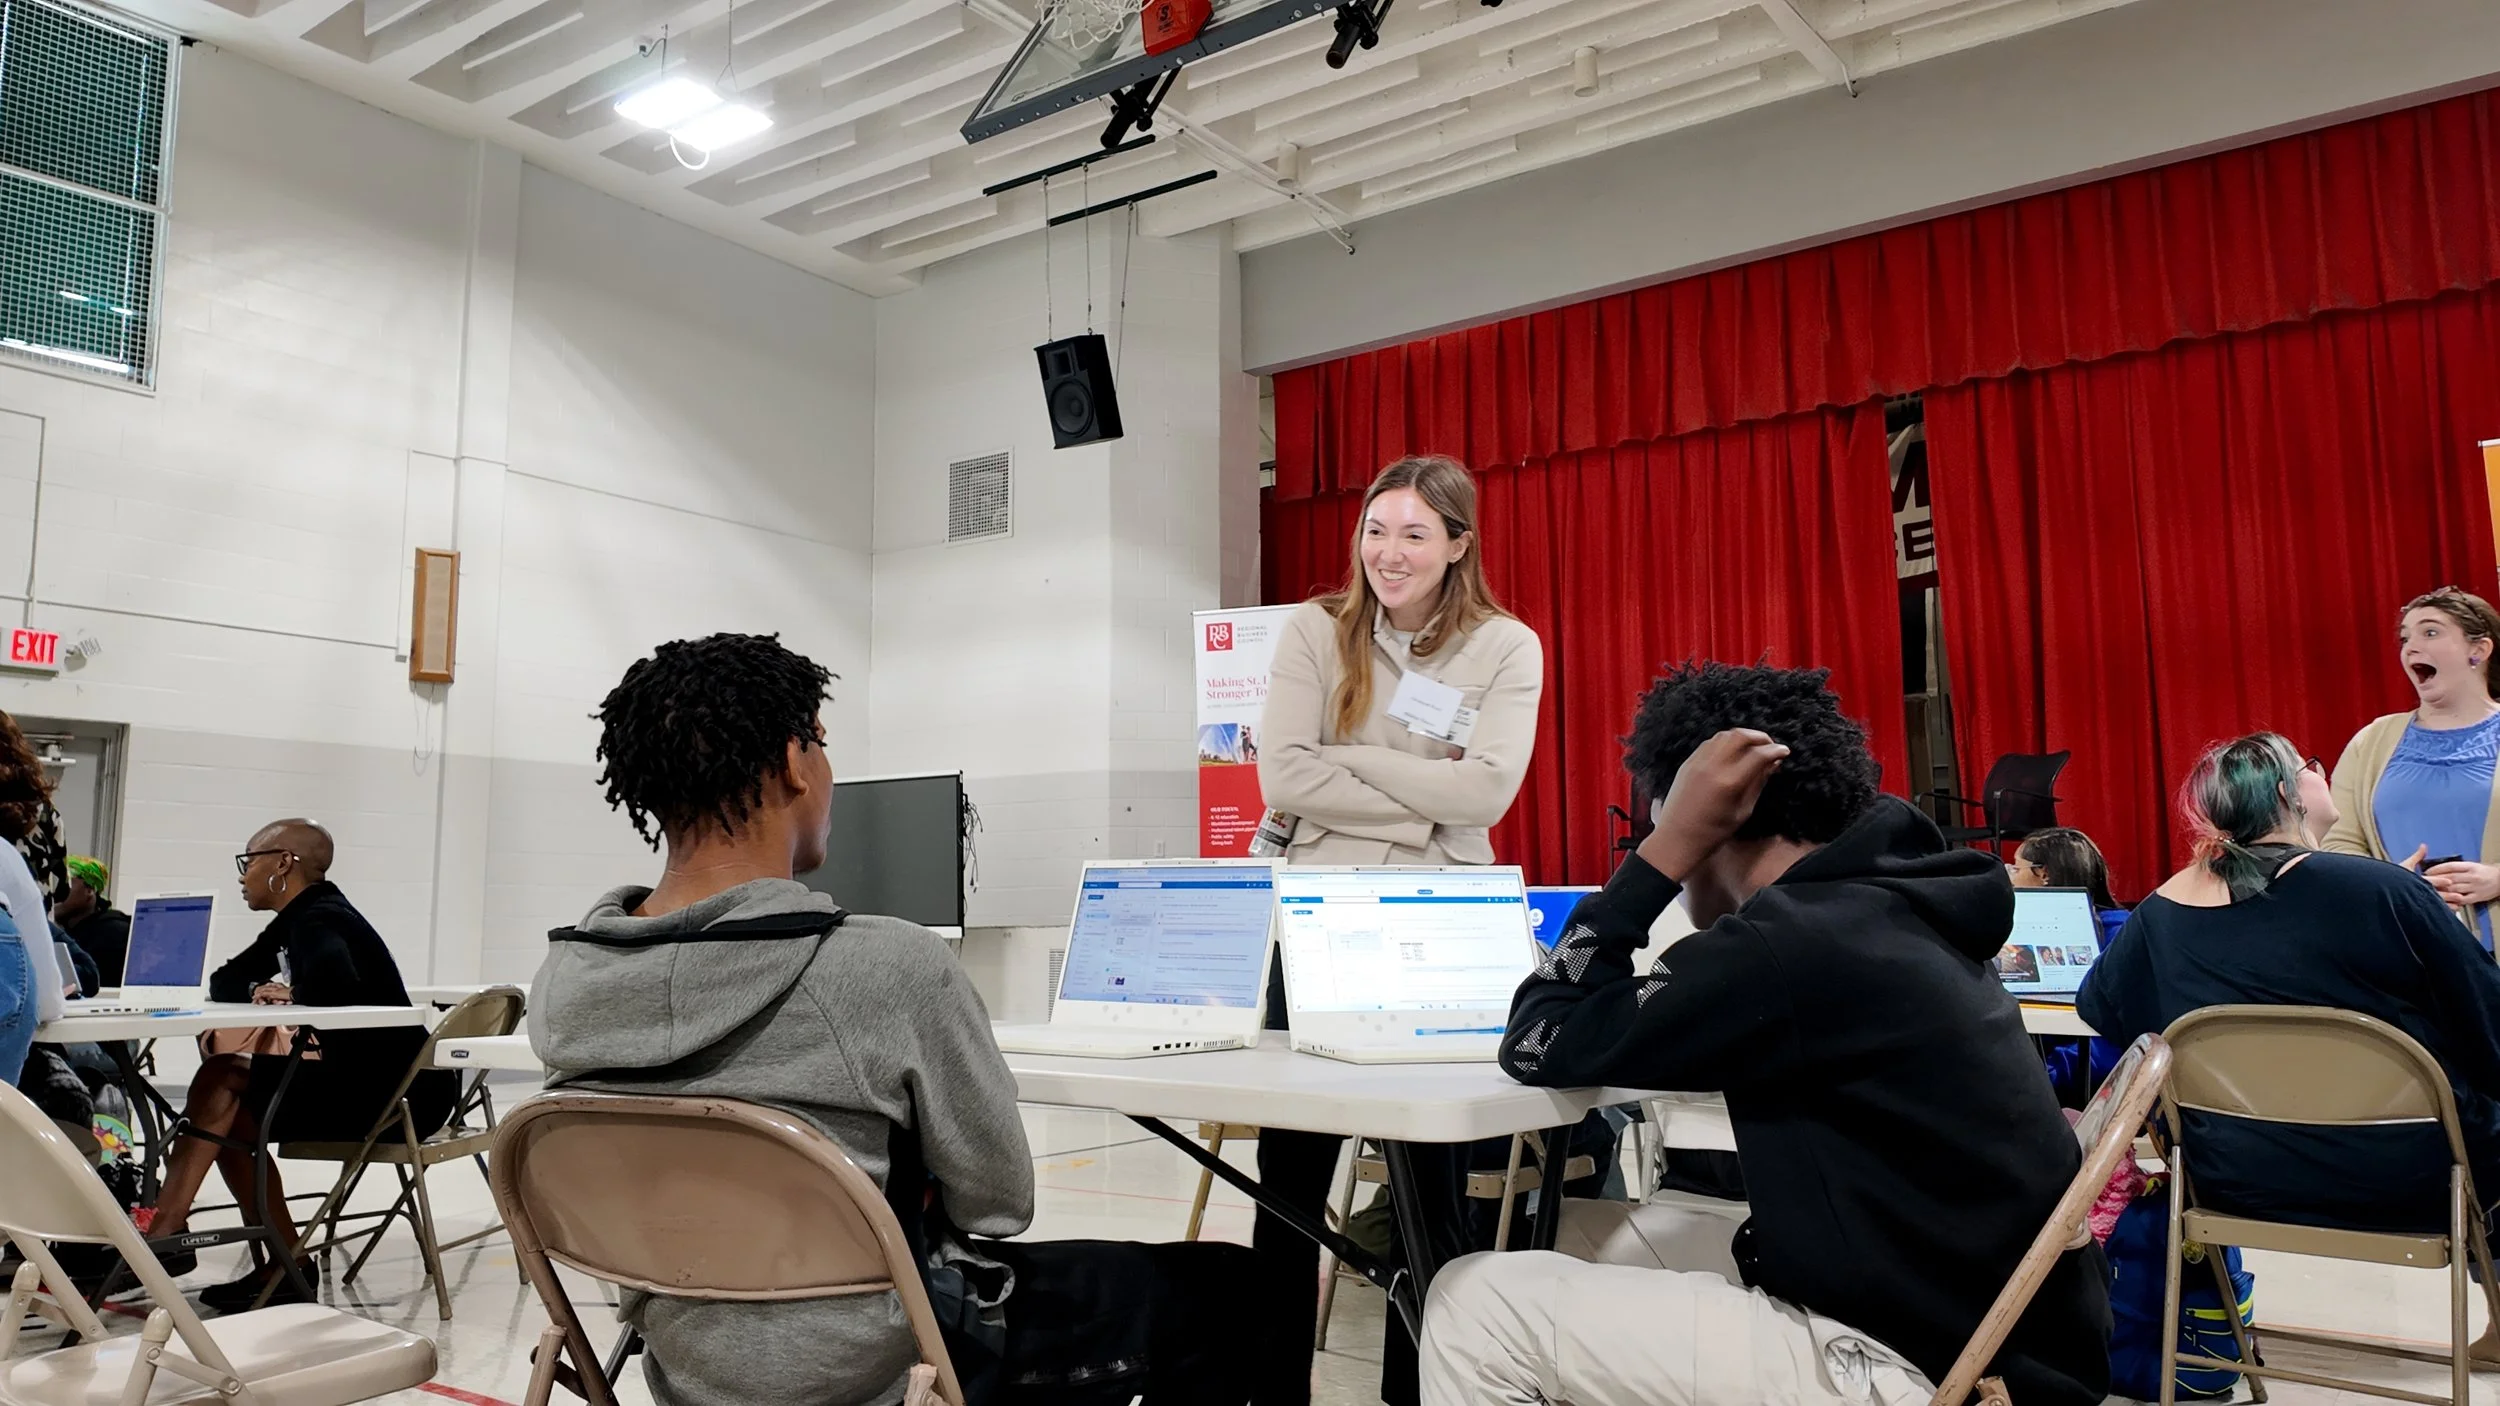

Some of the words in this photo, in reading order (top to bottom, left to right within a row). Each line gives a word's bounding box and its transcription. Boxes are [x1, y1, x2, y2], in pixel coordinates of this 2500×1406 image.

[1894, 519, 1935, 561] E
[11, 629, 59, 665] EXIT
[1206, 677, 1245, 689] Making
[1206, 689, 1251, 700] Stronger
